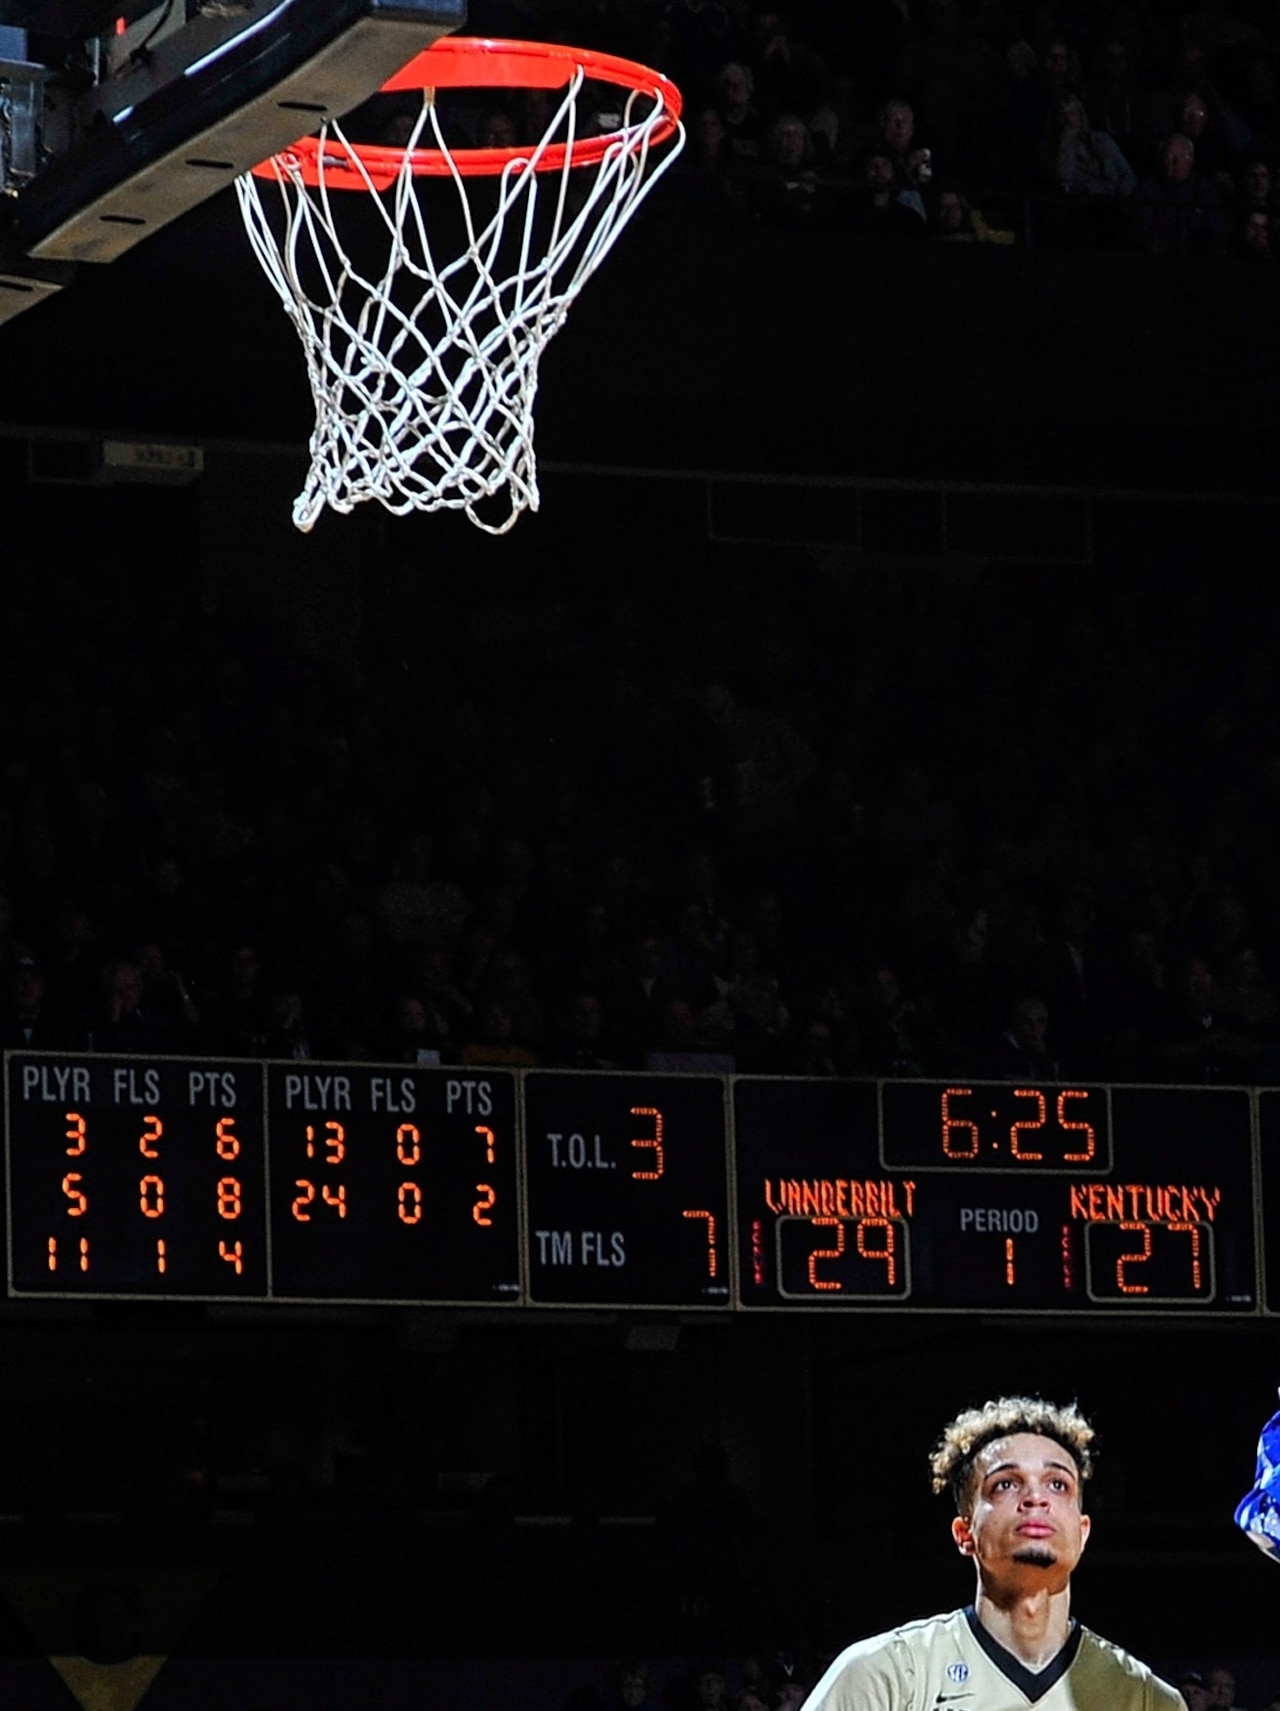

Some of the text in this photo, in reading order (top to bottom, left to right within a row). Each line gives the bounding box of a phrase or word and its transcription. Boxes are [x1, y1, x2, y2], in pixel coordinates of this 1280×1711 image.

[23, 1065, 237, 1108] PLYR FLS PTS
[285, 1074, 493, 1116] PLYR FLS PTS
[65, 1112, 241, 1161] 3 2 6
[306, 1121, 495, 1166] 13 0 7
[546, 1107, 664, 1180] T.O.L. 3
[941, 1088, 1095, 1162] 6:25
[61, 1172, 242, 1220] 5 0 8
[291, 1179, 496, 1226] 24 0 2
[764, 1178, 916, 1217] VANDERBILT
[1070, 1184, 1220, 1221] KENTUCKY
[535, 1230, 573, 1265] TM
[581, 1231, 626, 1267] FLS
[682, 1210, 717, 1277] 7
[960, 1208, 1039, 1233] PERIOD
[48, 1236, 243, 1275] 11 1 4
[808, 1217, 896, 1290] 29
[1005, 1238, 1015, 1286] 1
[1116, 1222, 1202, 1294] 27
